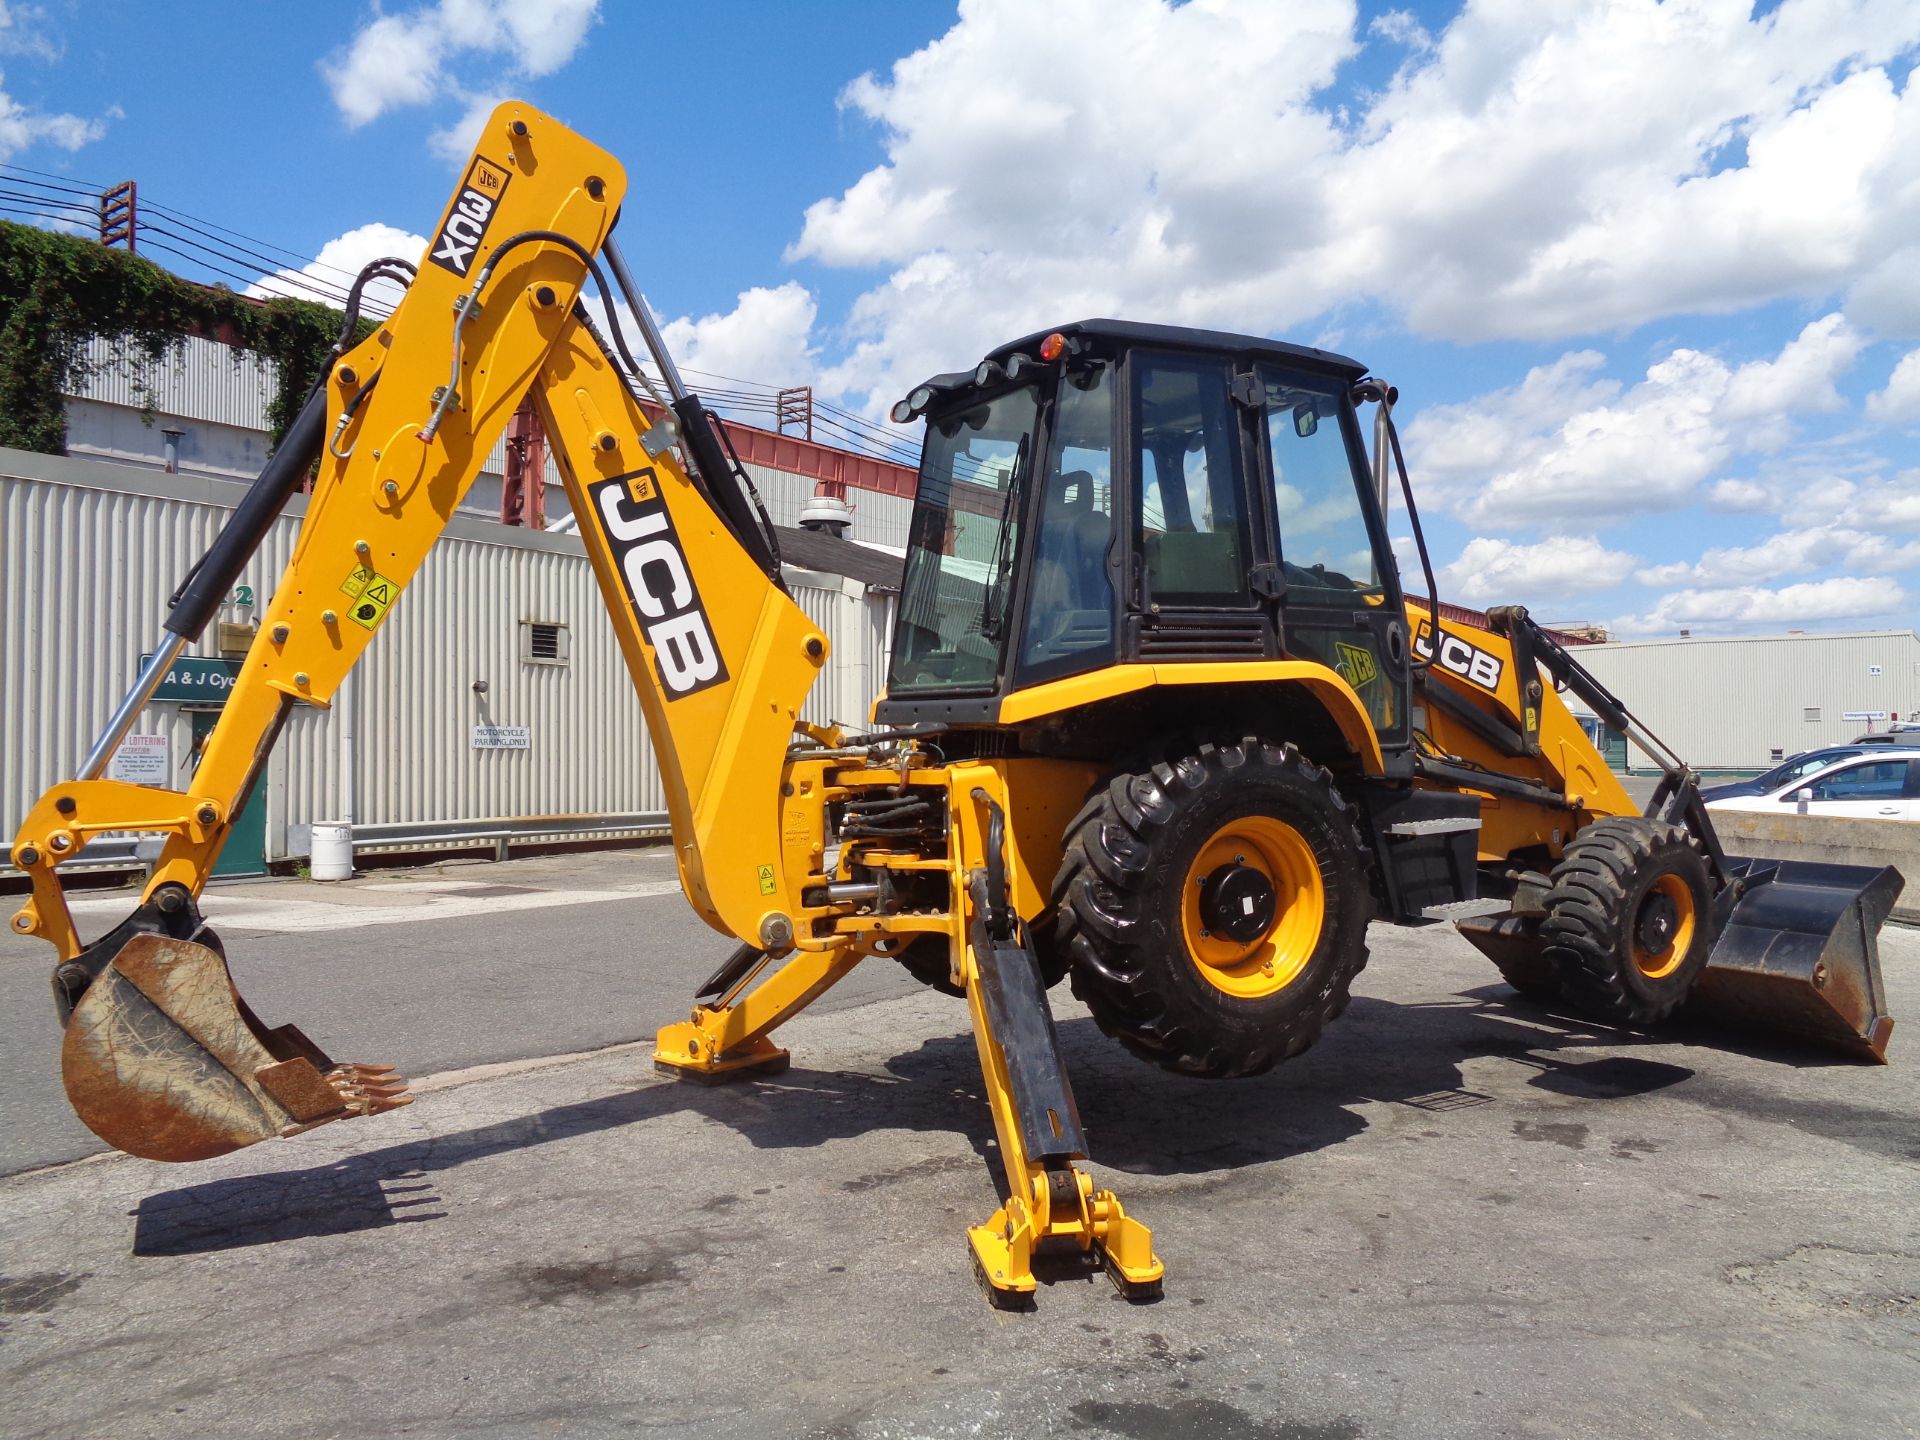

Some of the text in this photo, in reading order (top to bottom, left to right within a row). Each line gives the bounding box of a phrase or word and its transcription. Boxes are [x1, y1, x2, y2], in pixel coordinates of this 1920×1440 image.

[480, 169, 498, 188] JCB
[432, 190, 492, 272] 3CX
[600, 484, 719, 692] JCB
[1343, 647, 1374, 686] JCB
[1416, 631, 1500, 689] JCB
[164, 671, 176, 684] A
[181, 672, 192, 684] &
[196, 673, 206, 685] J
[129, 736, 166, 746] LOITERING
[475, 738, 526, 746] PARKING ONLY
[476, 728, 525, 737] MOTORCYCLE
